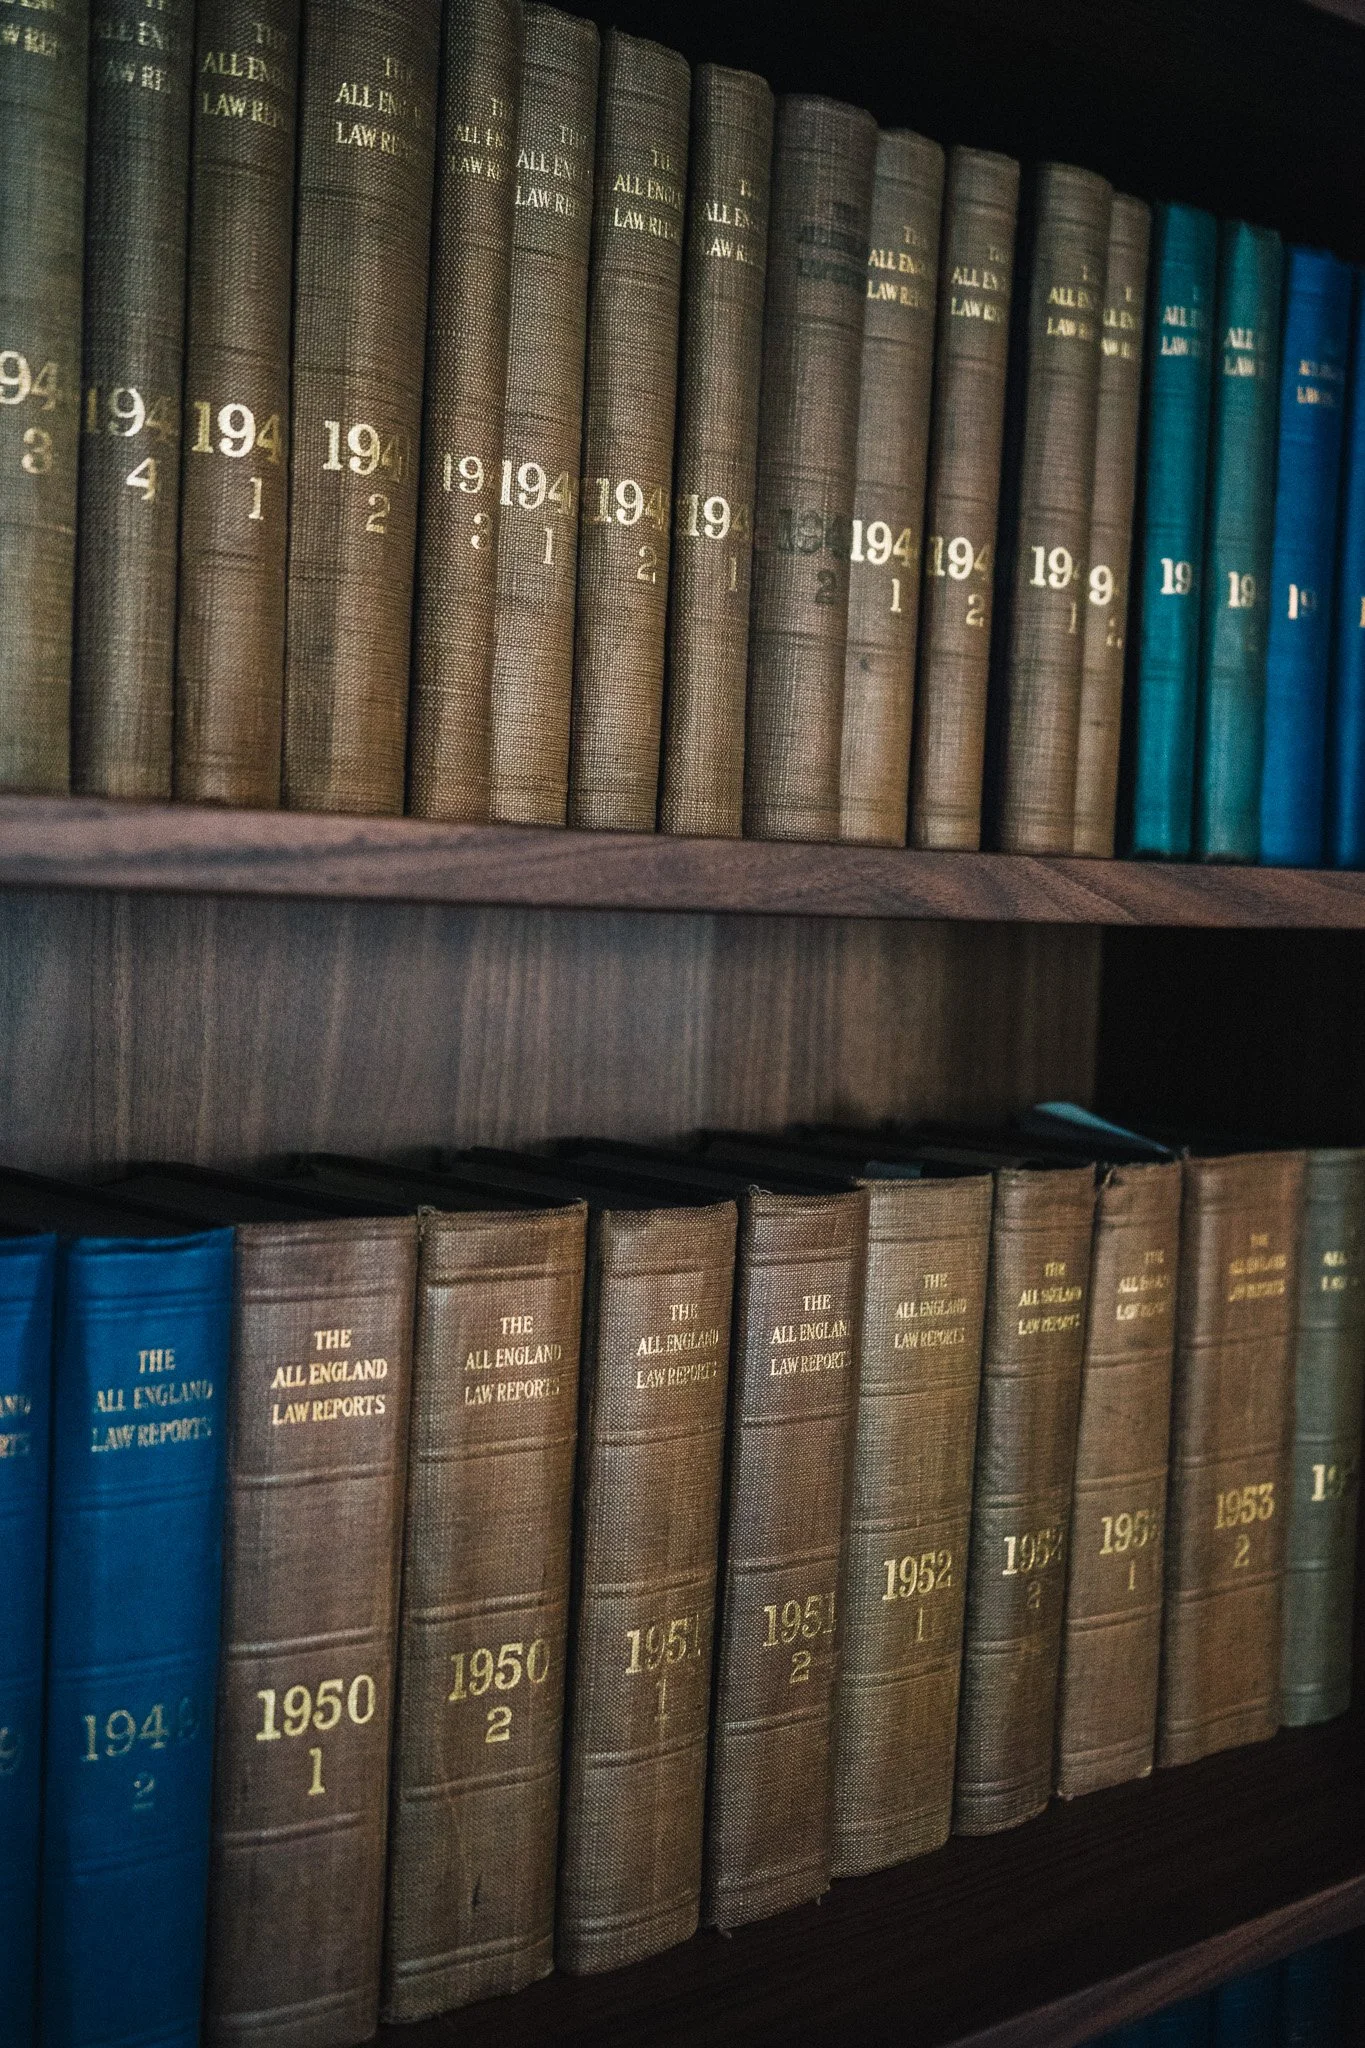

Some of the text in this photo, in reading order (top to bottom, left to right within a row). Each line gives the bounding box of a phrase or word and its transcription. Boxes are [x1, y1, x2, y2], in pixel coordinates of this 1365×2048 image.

[202, 51, 243, 77] ALL
[203, 92, 246, 118] LAW
[335, 82, 373, 108] ALL
[335, 121, 376, 147] LAW
[515, 150, 549, 174] ALL
[514, 185, 551, 208] LAW
[613, 174, 643, 196] ALL
[613, 207, 645, 232] LAW
[704, 200, 732, 225] ALL
[868, 248, 898, 270] ALL
[866, 280, 897, 301] LAW
[952, 266, 979, 288] ALL
[951, 298, 981, 318] LAW
[1050, 286, 1076, 308] ALL
[1046, 316, 1076, 338] LAW
[21, 426, 52, 474] 3
[125, 456, 160, 500] 4
[248, 476, 264, 520] 1
[366, 493, 390, 534] 2
[543, 527, 554, 566] 1
[636, 545, 657, 585] 2
[728, 556, 738, 593] 1
[890, 577, 903, 613] 1
[966, 594, 984, 628] 2
[1068, 602, 1077, 634] 1
[923, 1273, 948, 1290] THE
[669, 1304, 698, 1321] THE
[803, 1294, 831, 1312] THE
[895, 1302, 919, 1318] ALL
[1018, 1290, 1038, 1308] ALL
[500, 1316, 533, 1335] THE
[770, 1326, 797, 1345] ALL
[314, 1329, 351, 1350] THE
[636, 1329, 719, 1356] ALL ENGLAND
[895, 1332, 921, 1349] LAW
[138, 1349, 176, 1374] THE
[464, 1344, 562, 1371] ALL ENGLAND
[770, 1351, 850, 1376] LAW REPORT
[271, 1358, 388, 1390] ALL ENGLAND
[636, 1369, 666, 1389] LAW
[94, 1379, 213, 1413] ALL ENGLAND
[464, 1377, 561, 1406] LAW REPORTS
[272, 1395, 386, 1426] LAW REPORTS
[92, 1416, 213, 1453] LAW REPORTS
[1215, 1483, 1275, 1530] 1953
[1233, 1534, 1249, 1569] 2
[882, 1550, 952, 1601] 1952
[1128, 1560, 1136, 1591] 1
[763, 1591, 836, 1647] 1951
[916, 1607, 926, 1642] 1
[449, 1638, 550, 1701] 1950
[789, 1650, 812, 1683] 2
[256, 1674, 376, 1742] 1950
[656, 1679, 669, 1721] 1
[485, 1706, 512, 1744] 2
[307, 1748, 325, 1795] 1
